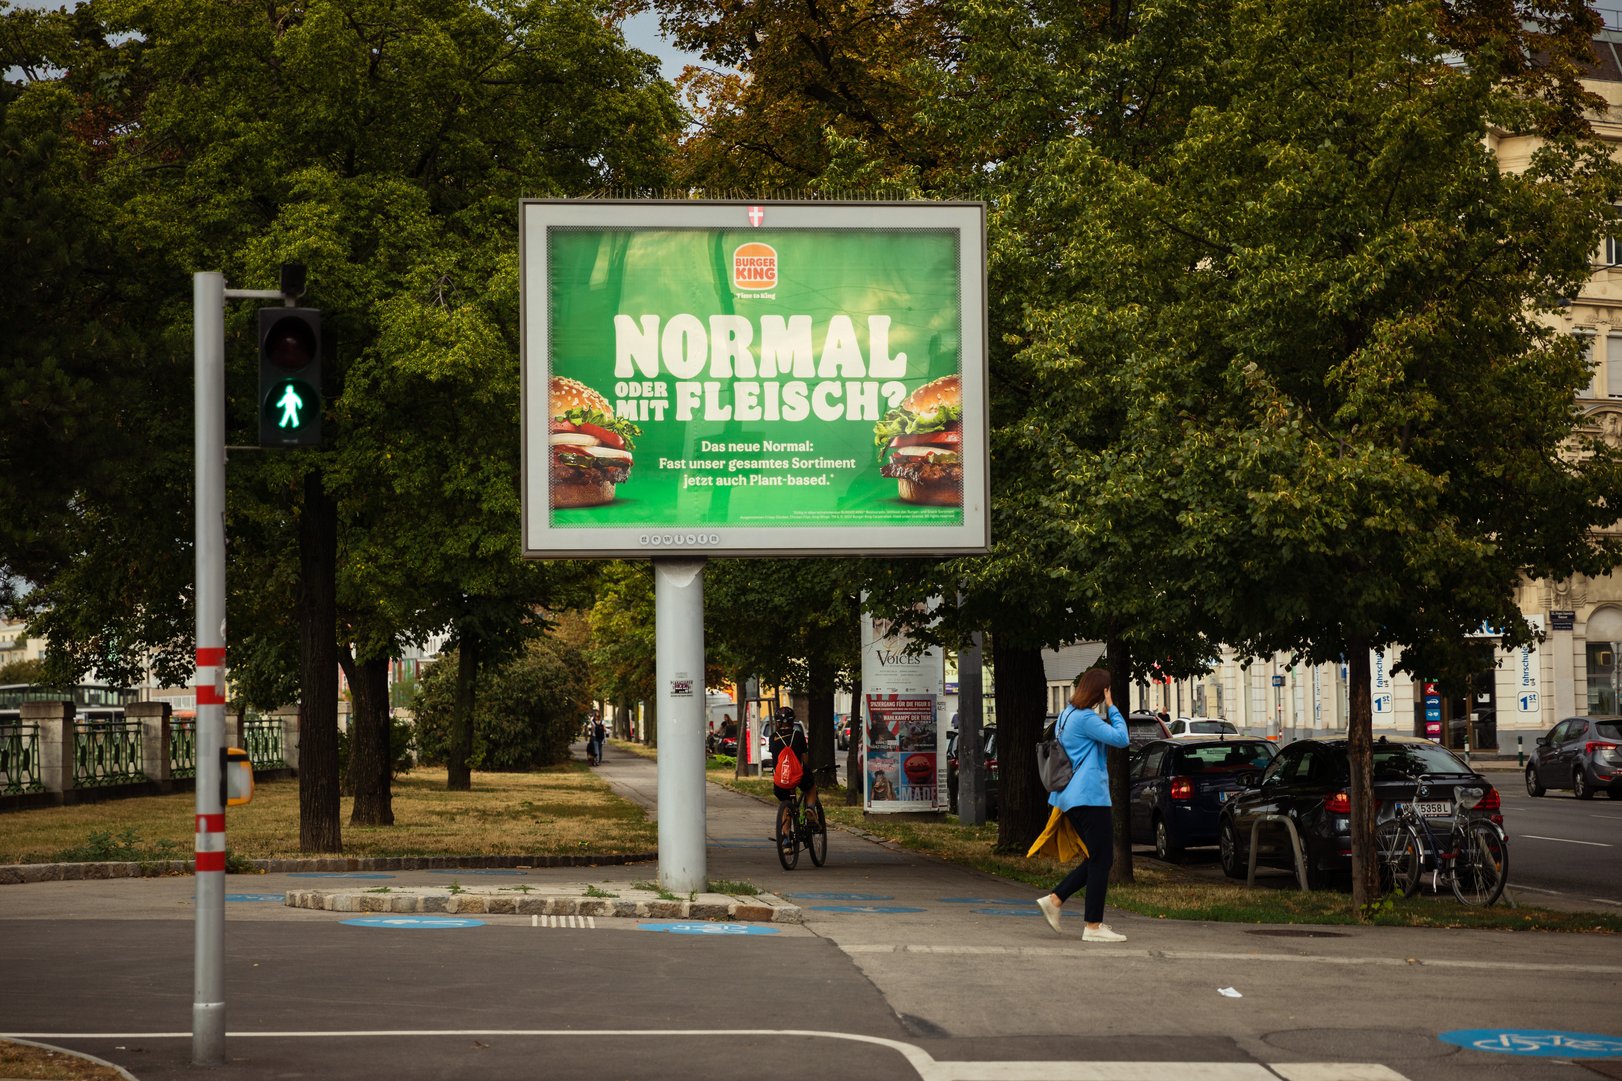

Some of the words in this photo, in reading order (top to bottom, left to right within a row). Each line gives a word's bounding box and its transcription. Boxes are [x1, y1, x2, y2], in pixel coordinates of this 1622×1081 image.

[736, 258, 776, 267] BURGER
[736, 267, 776, 280] KING
[613, 313, 907, 379] NORMAL
[614, 382, 668, 398] ODER
[674, 380, 907, 422] FLEISCH?
[614, 399, 670, 422] MIT
[701, 440, 725, 453] Das
[728, 444, 760, 453] neue
[763, 440, 814, 453] Normal:
[659, 457, 686, 469] Fast
[689, 459, 725, 469] unser
[728, 458, 788, 472] gesamtes
[792, 457, 856, 469] Sortiment
[683, 474, 713, 489] jetzt
[715, 474, 746, 486] auch
